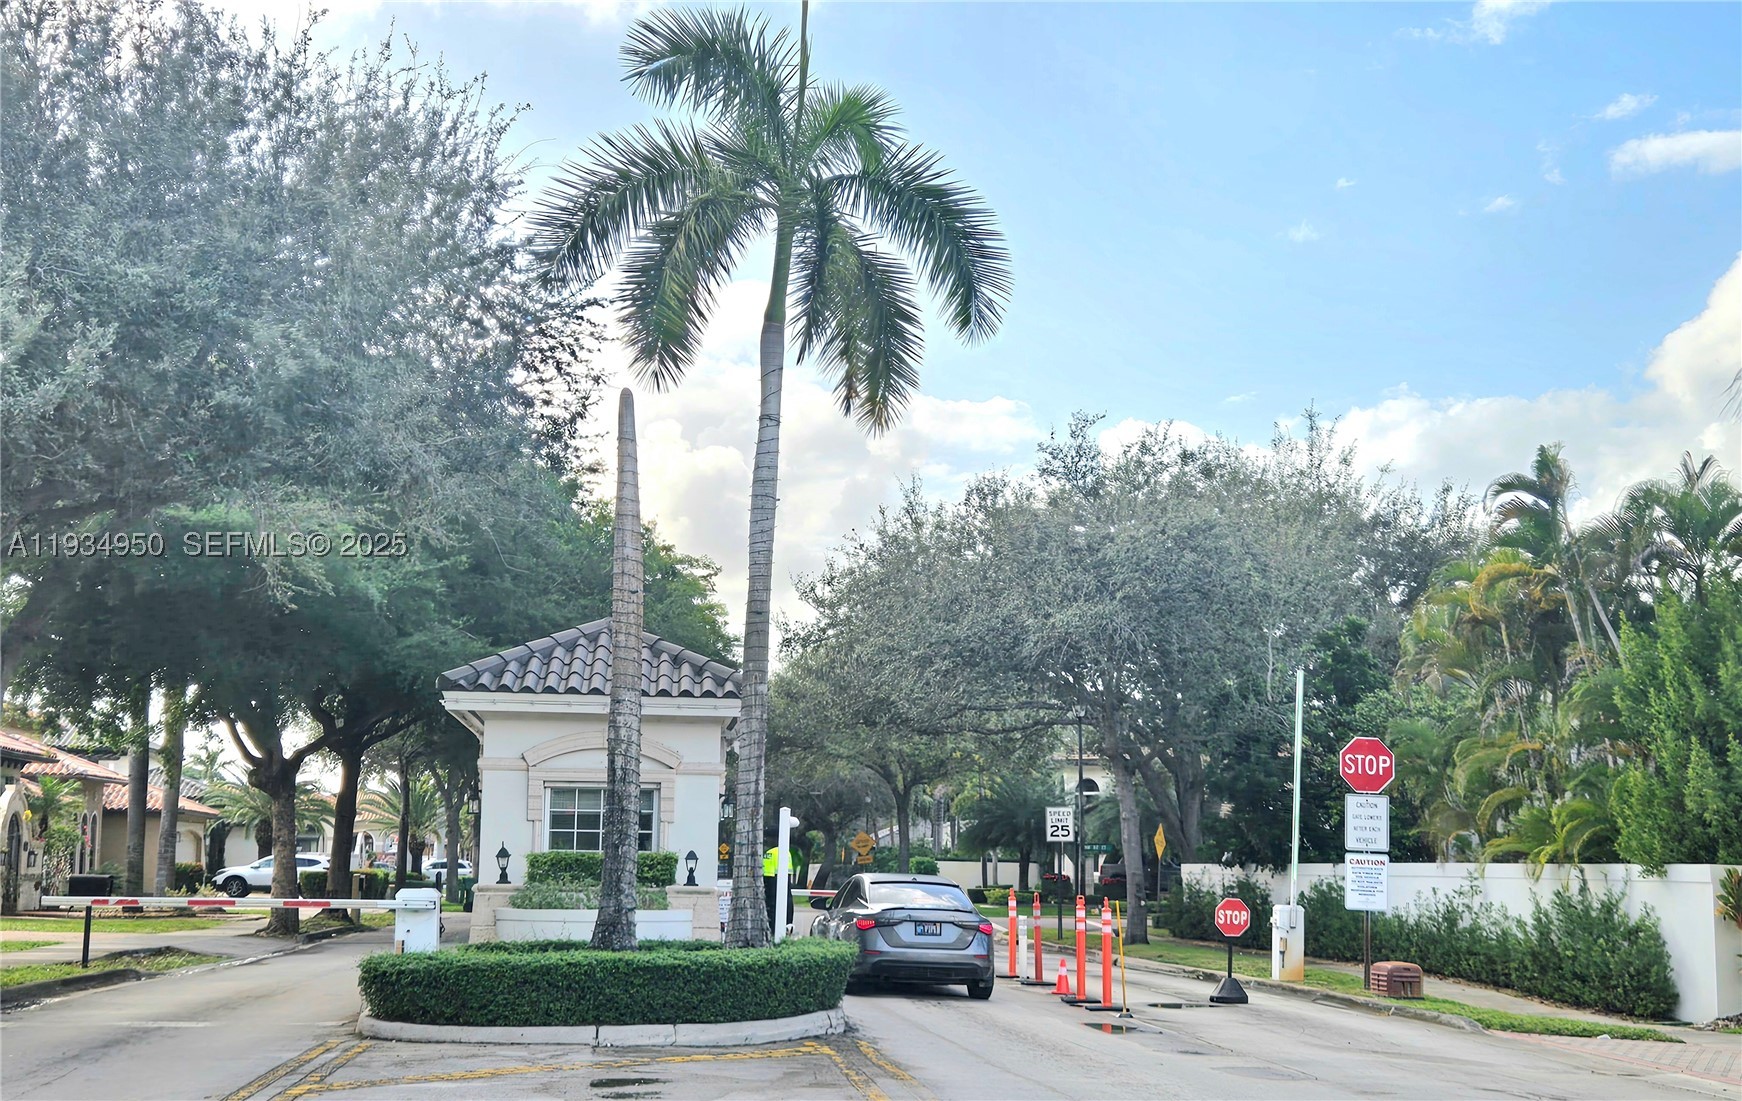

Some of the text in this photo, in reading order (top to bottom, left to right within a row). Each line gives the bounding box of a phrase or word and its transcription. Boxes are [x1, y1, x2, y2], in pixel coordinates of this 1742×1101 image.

[1344, 754, 1391, 775] STOP
[1050, 824, 1071, 838] 25
[1349, 858, 1386, 867] CAUTION
[1217, 909, 1248, 926] STOP
